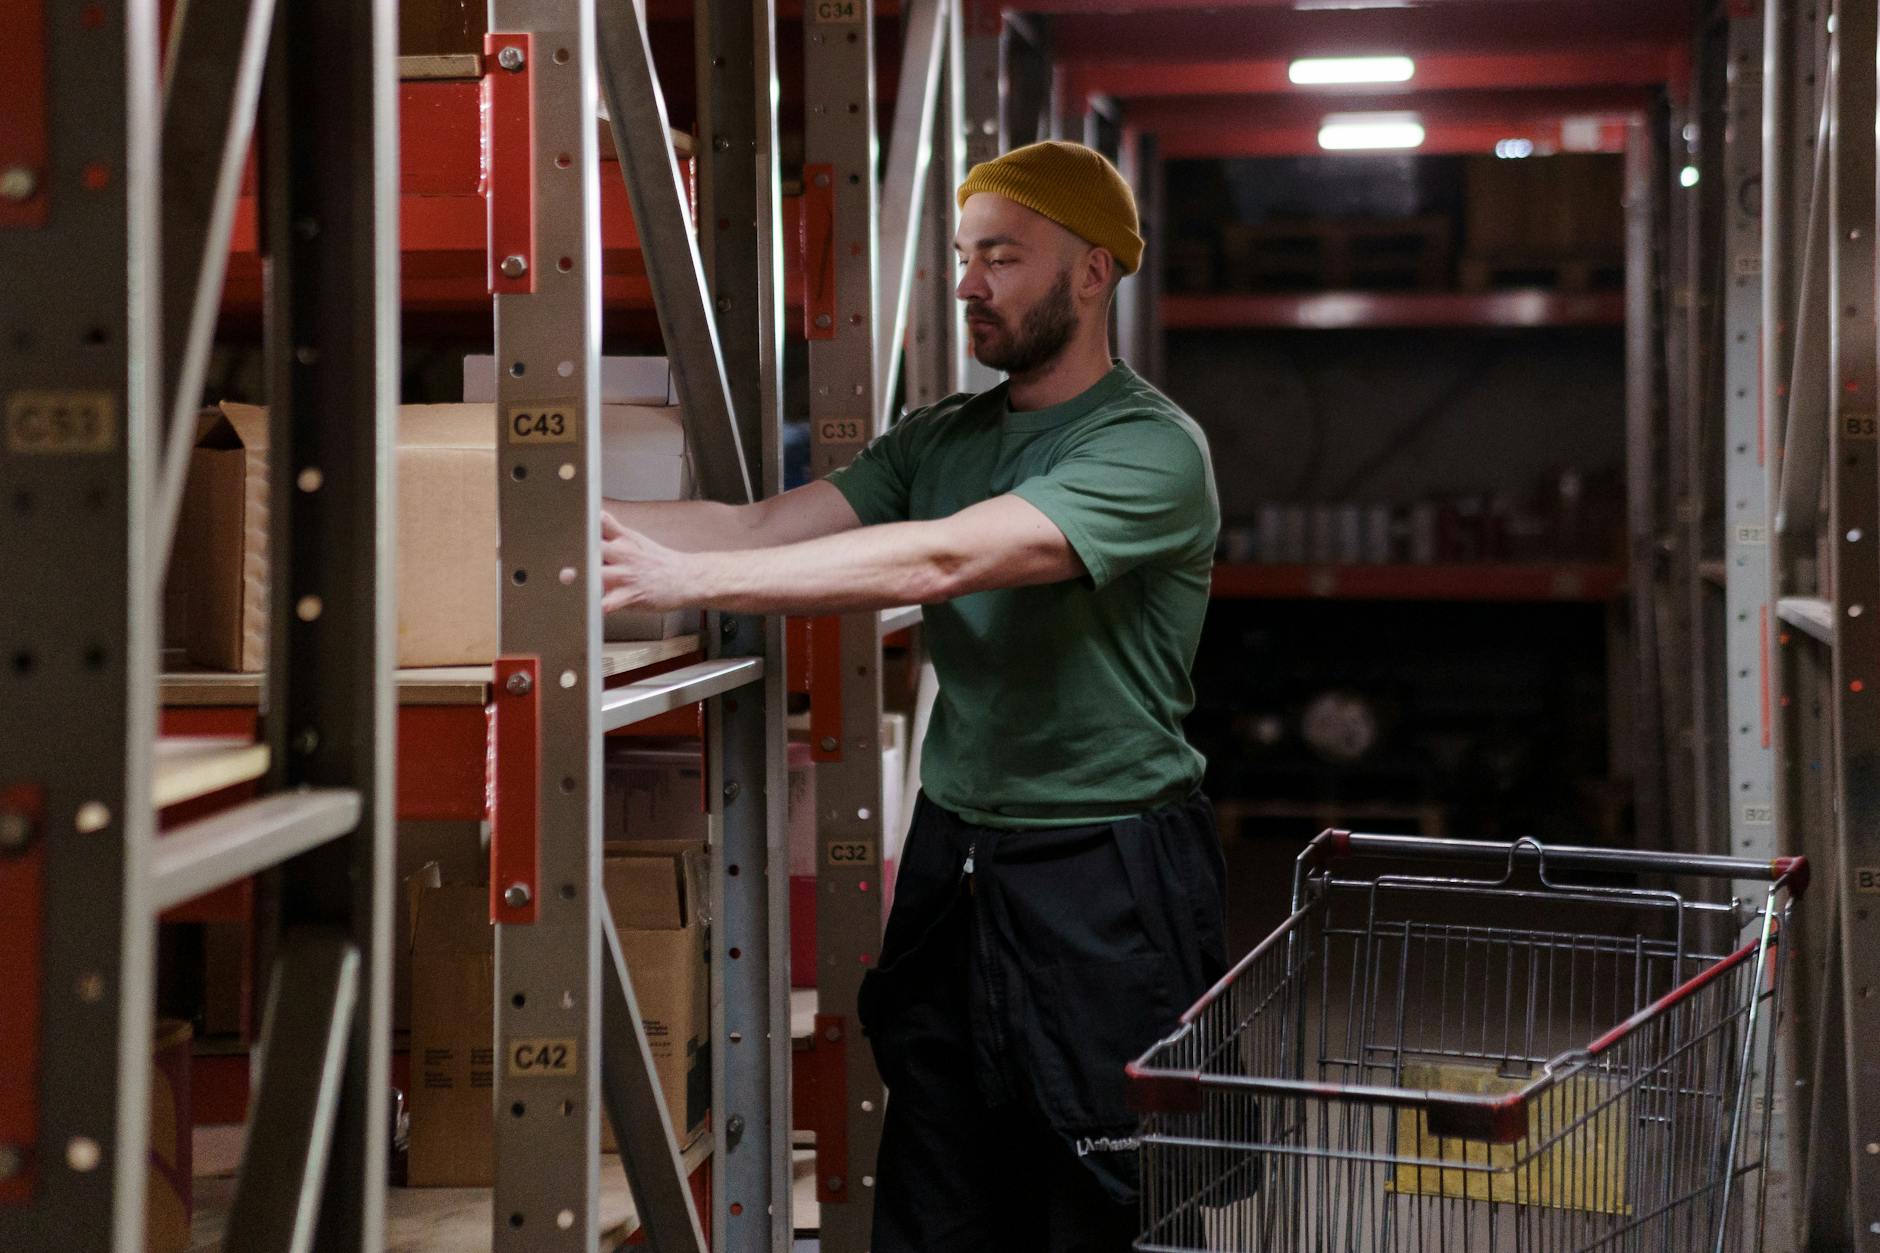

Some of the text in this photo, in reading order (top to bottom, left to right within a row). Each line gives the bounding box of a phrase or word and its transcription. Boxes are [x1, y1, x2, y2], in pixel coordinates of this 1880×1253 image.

[819, 2, 853, 18] C34
[513, 413, 565, 437] C43
[822, 423, 857, 439] C33
[831, 844, 866, 861] C32
[515, 1044, 567, 1069] C42
